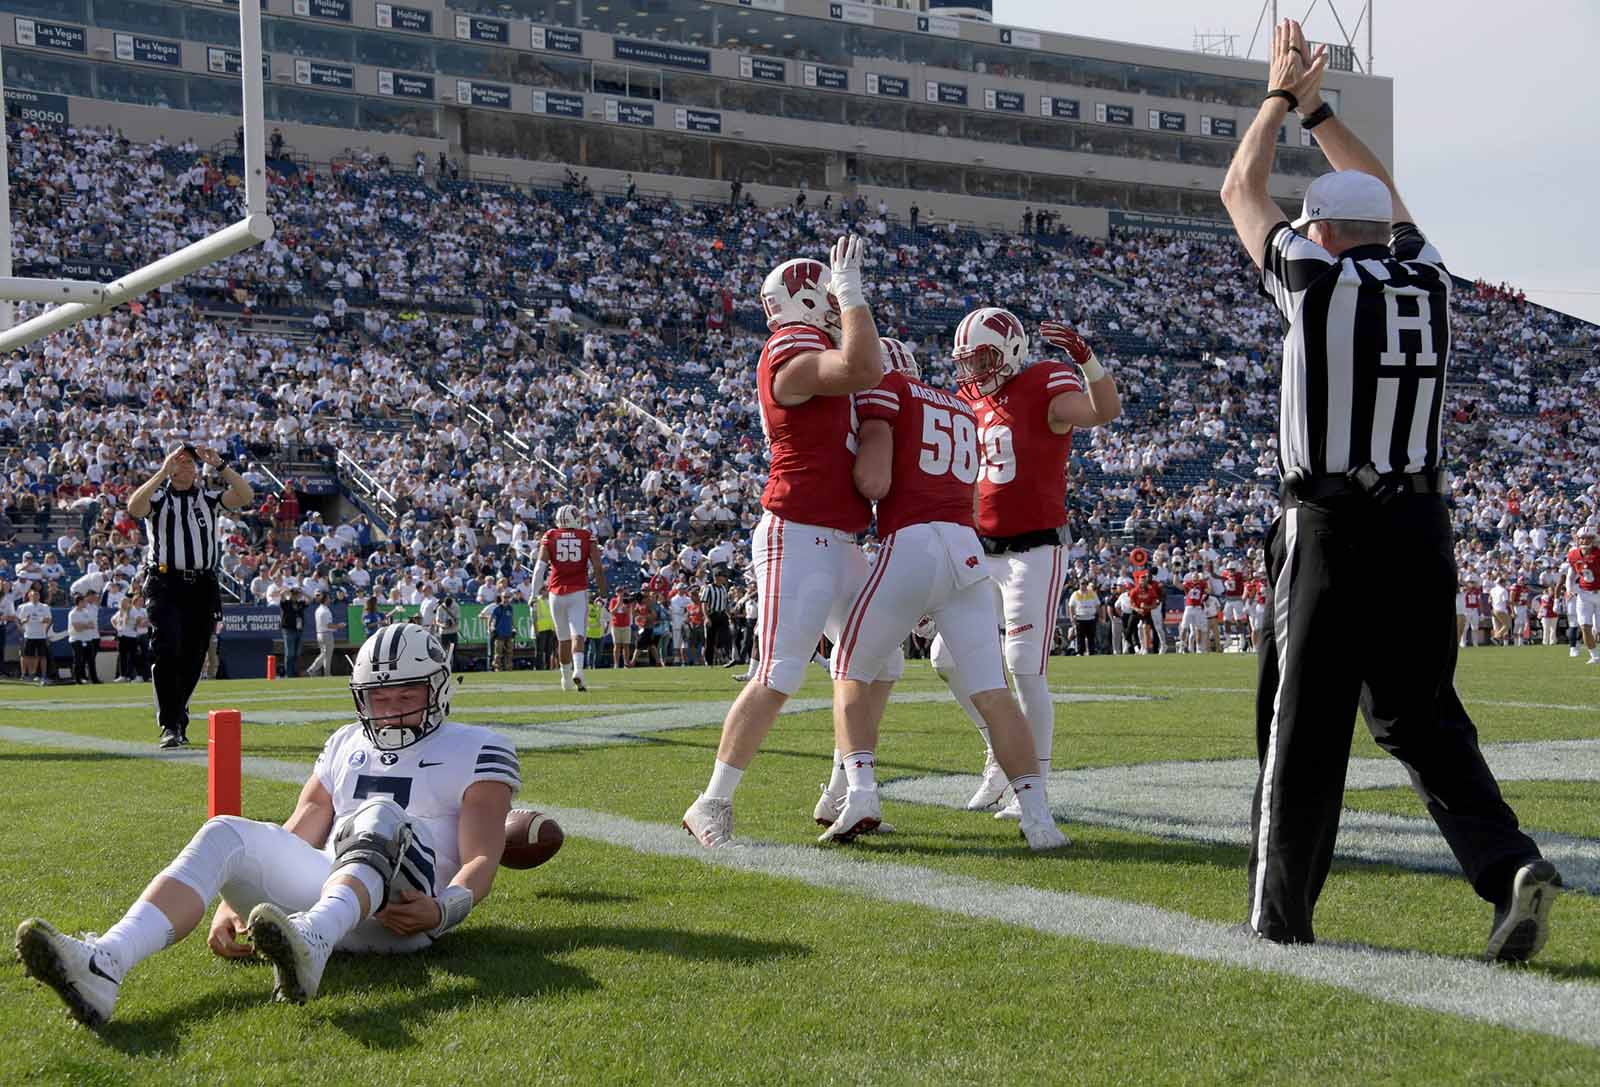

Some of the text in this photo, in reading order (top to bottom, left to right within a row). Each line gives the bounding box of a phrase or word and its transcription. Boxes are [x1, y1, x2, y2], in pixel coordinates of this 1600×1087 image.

[37, 25, 53, 35] Las
[54, 27, 82, 42] Vegas
[50, 38, 73, 48] BOWL
[135, 40, 151, 51] Las
[152, 42, 177, 55] Vegas
[147, 53, 168, 62] BOWL
[4, 91, 39, 102] ncerns
[1183, 231, 1217, 242] LOCATION
[61, 264, 91, 275] Portal
[1378, 283, 1438, 367] R
[918, 403, 980, 485] 58
[198, 518, 206, 528] C
[556, 539, 582, 562] 55
[223, 615, 281, 624] HIGH PROTEIN
[226, 623, 280, 632] MILK SHAKE
